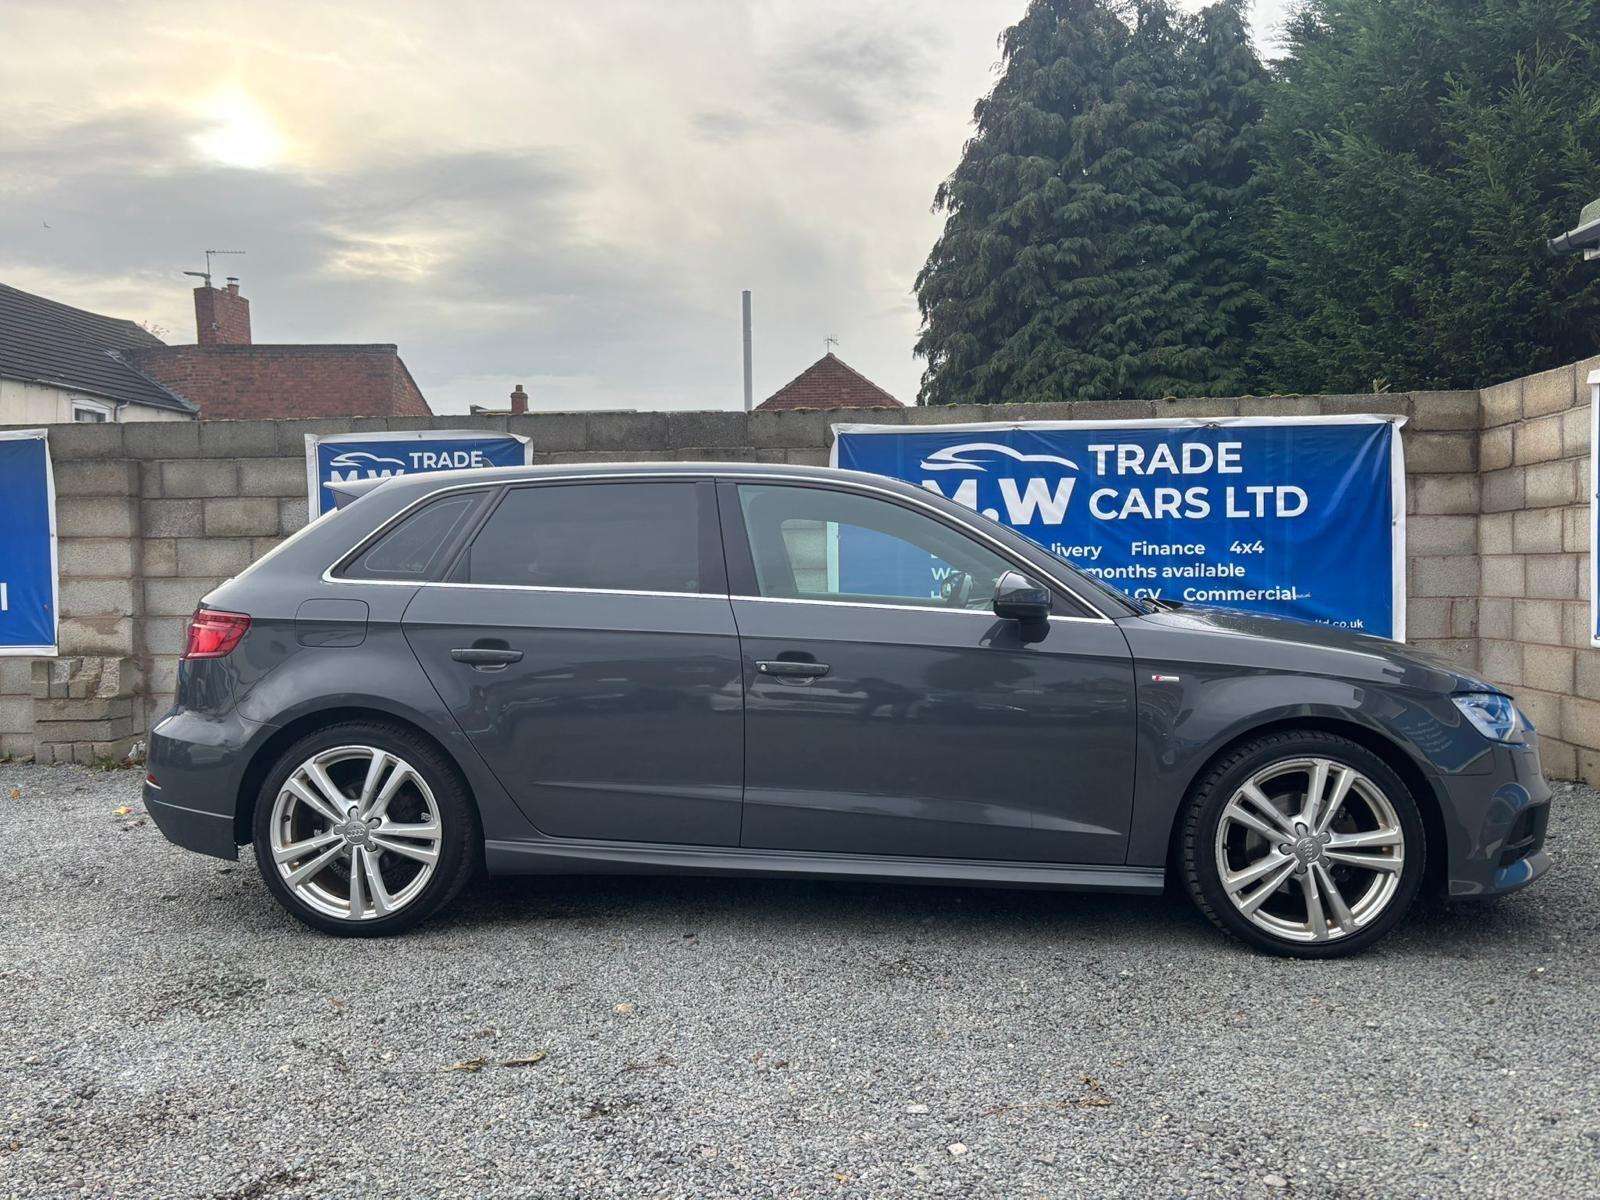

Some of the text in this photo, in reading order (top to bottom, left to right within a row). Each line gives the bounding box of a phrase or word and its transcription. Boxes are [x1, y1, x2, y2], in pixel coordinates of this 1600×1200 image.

[409, 451, 483, 469] TRADE
[1087, 442, 1243, 476] TRADE
[1088, 486, 1309, 521] CARS LTD
[1131, 541, 1206, 556] Finance
[1229, 540, 1265, 554] 4x4
[1162, 562, 1246, 578] available
[1183, 586, 1297, 601] Commercial
